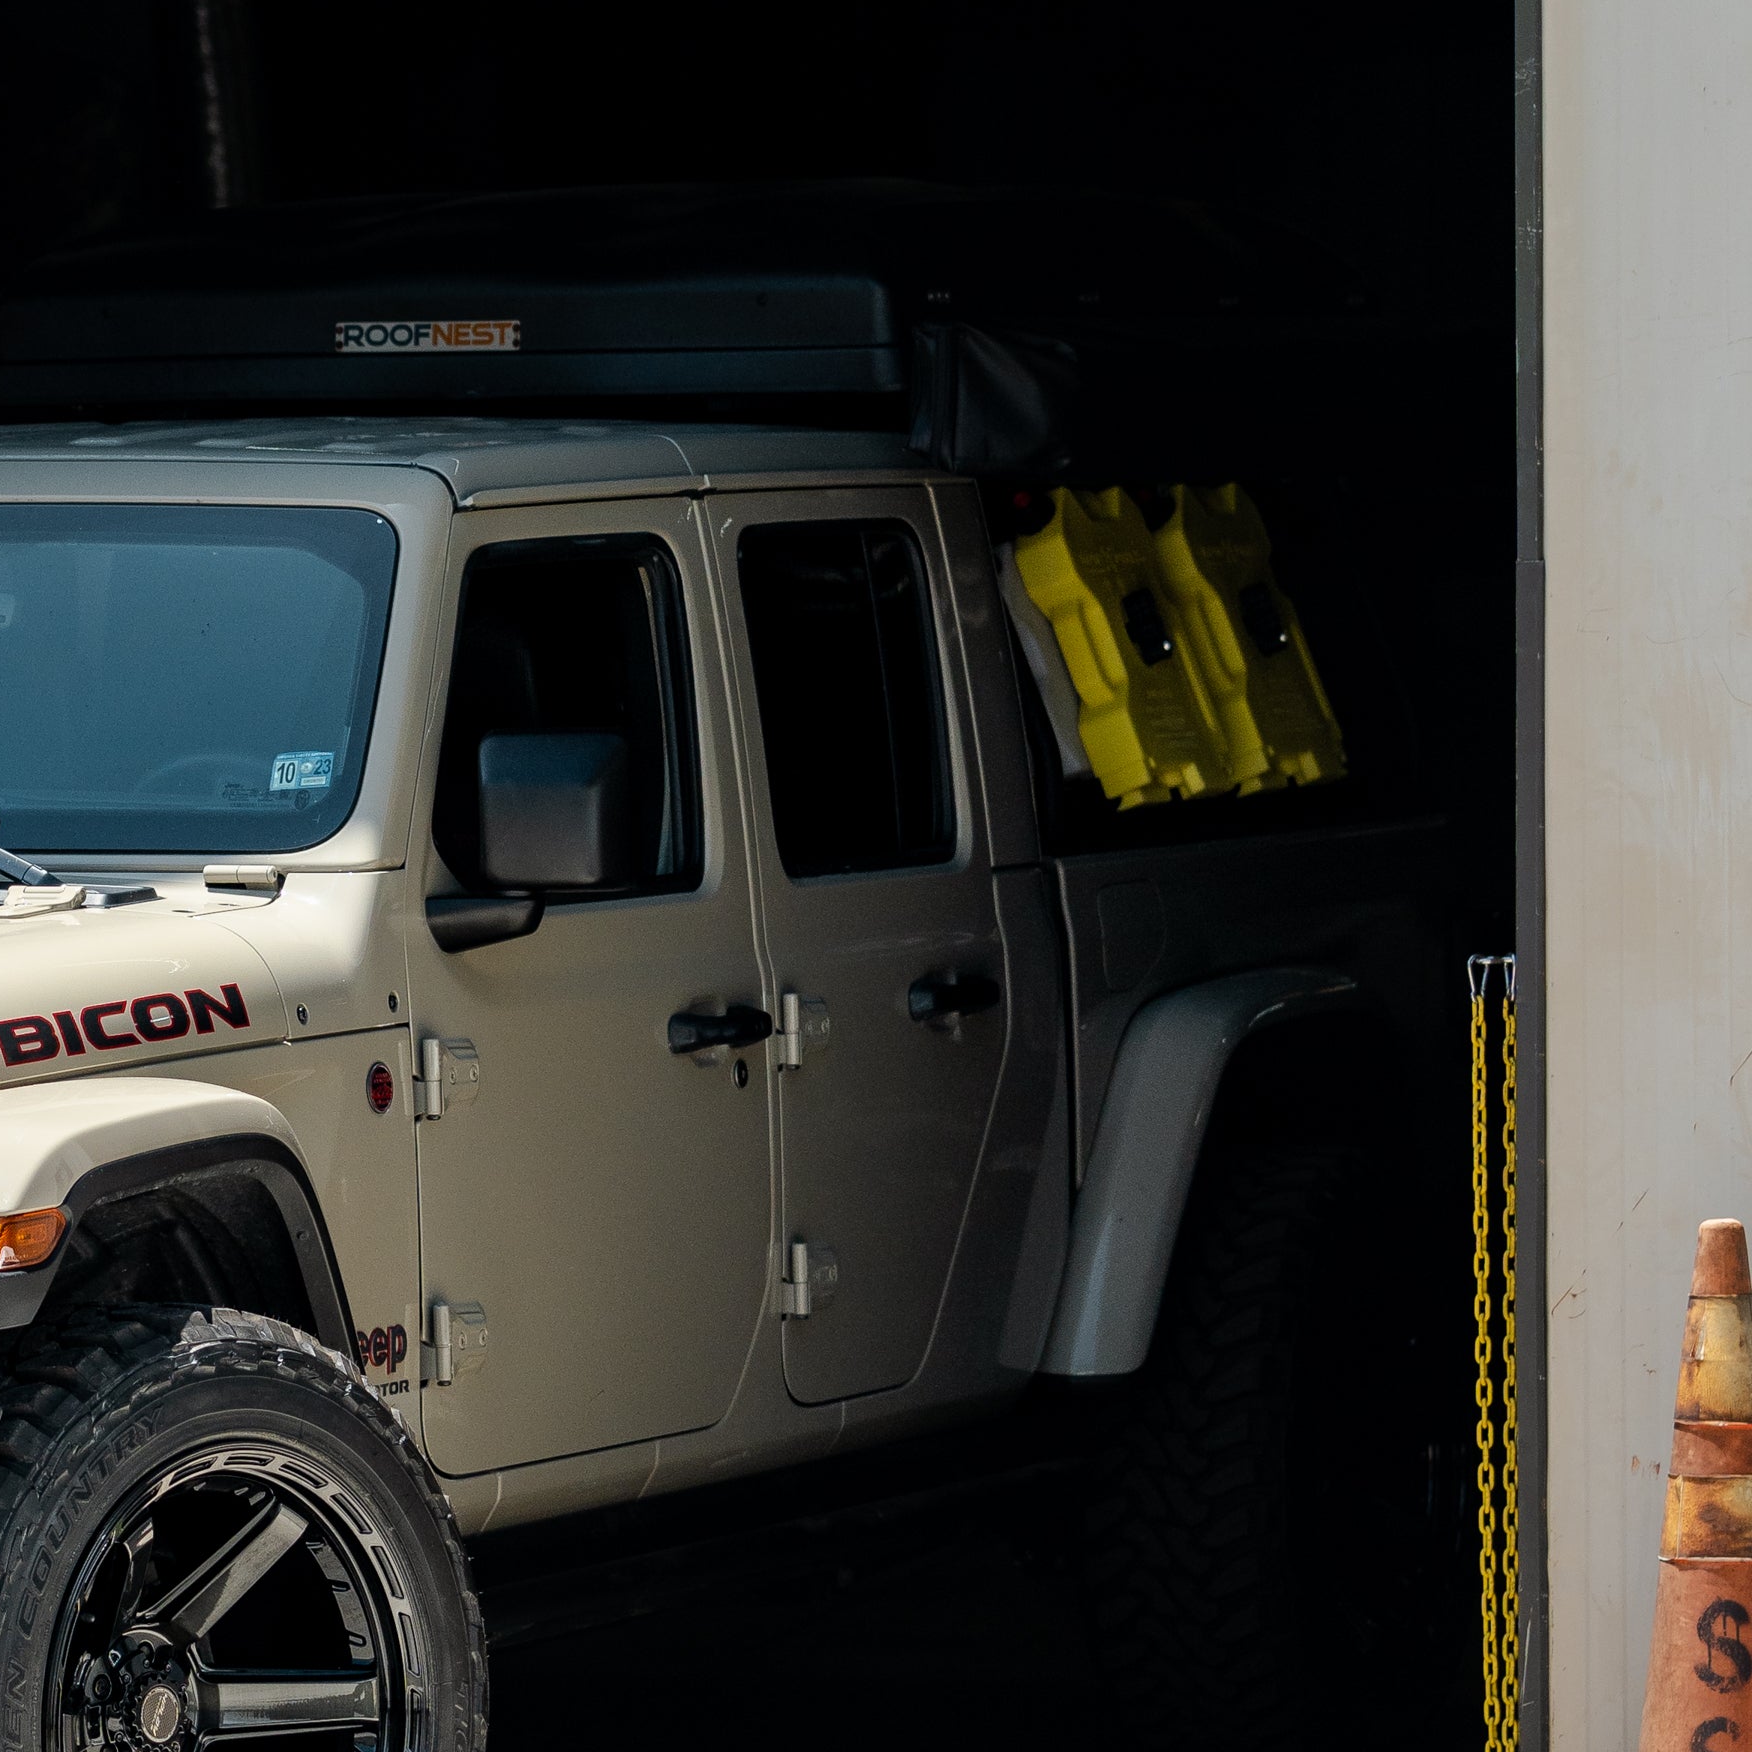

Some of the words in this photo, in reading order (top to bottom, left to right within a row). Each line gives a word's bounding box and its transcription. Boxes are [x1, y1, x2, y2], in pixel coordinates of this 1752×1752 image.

[346, 321, 514, 347] ROOFNEST
[277, 761, 296, 784] 10
[313, 758, 332, 775] 23
[356, 1323, 408, 1376] eep
[17, 1405, 163, 1640] COUNTRY
